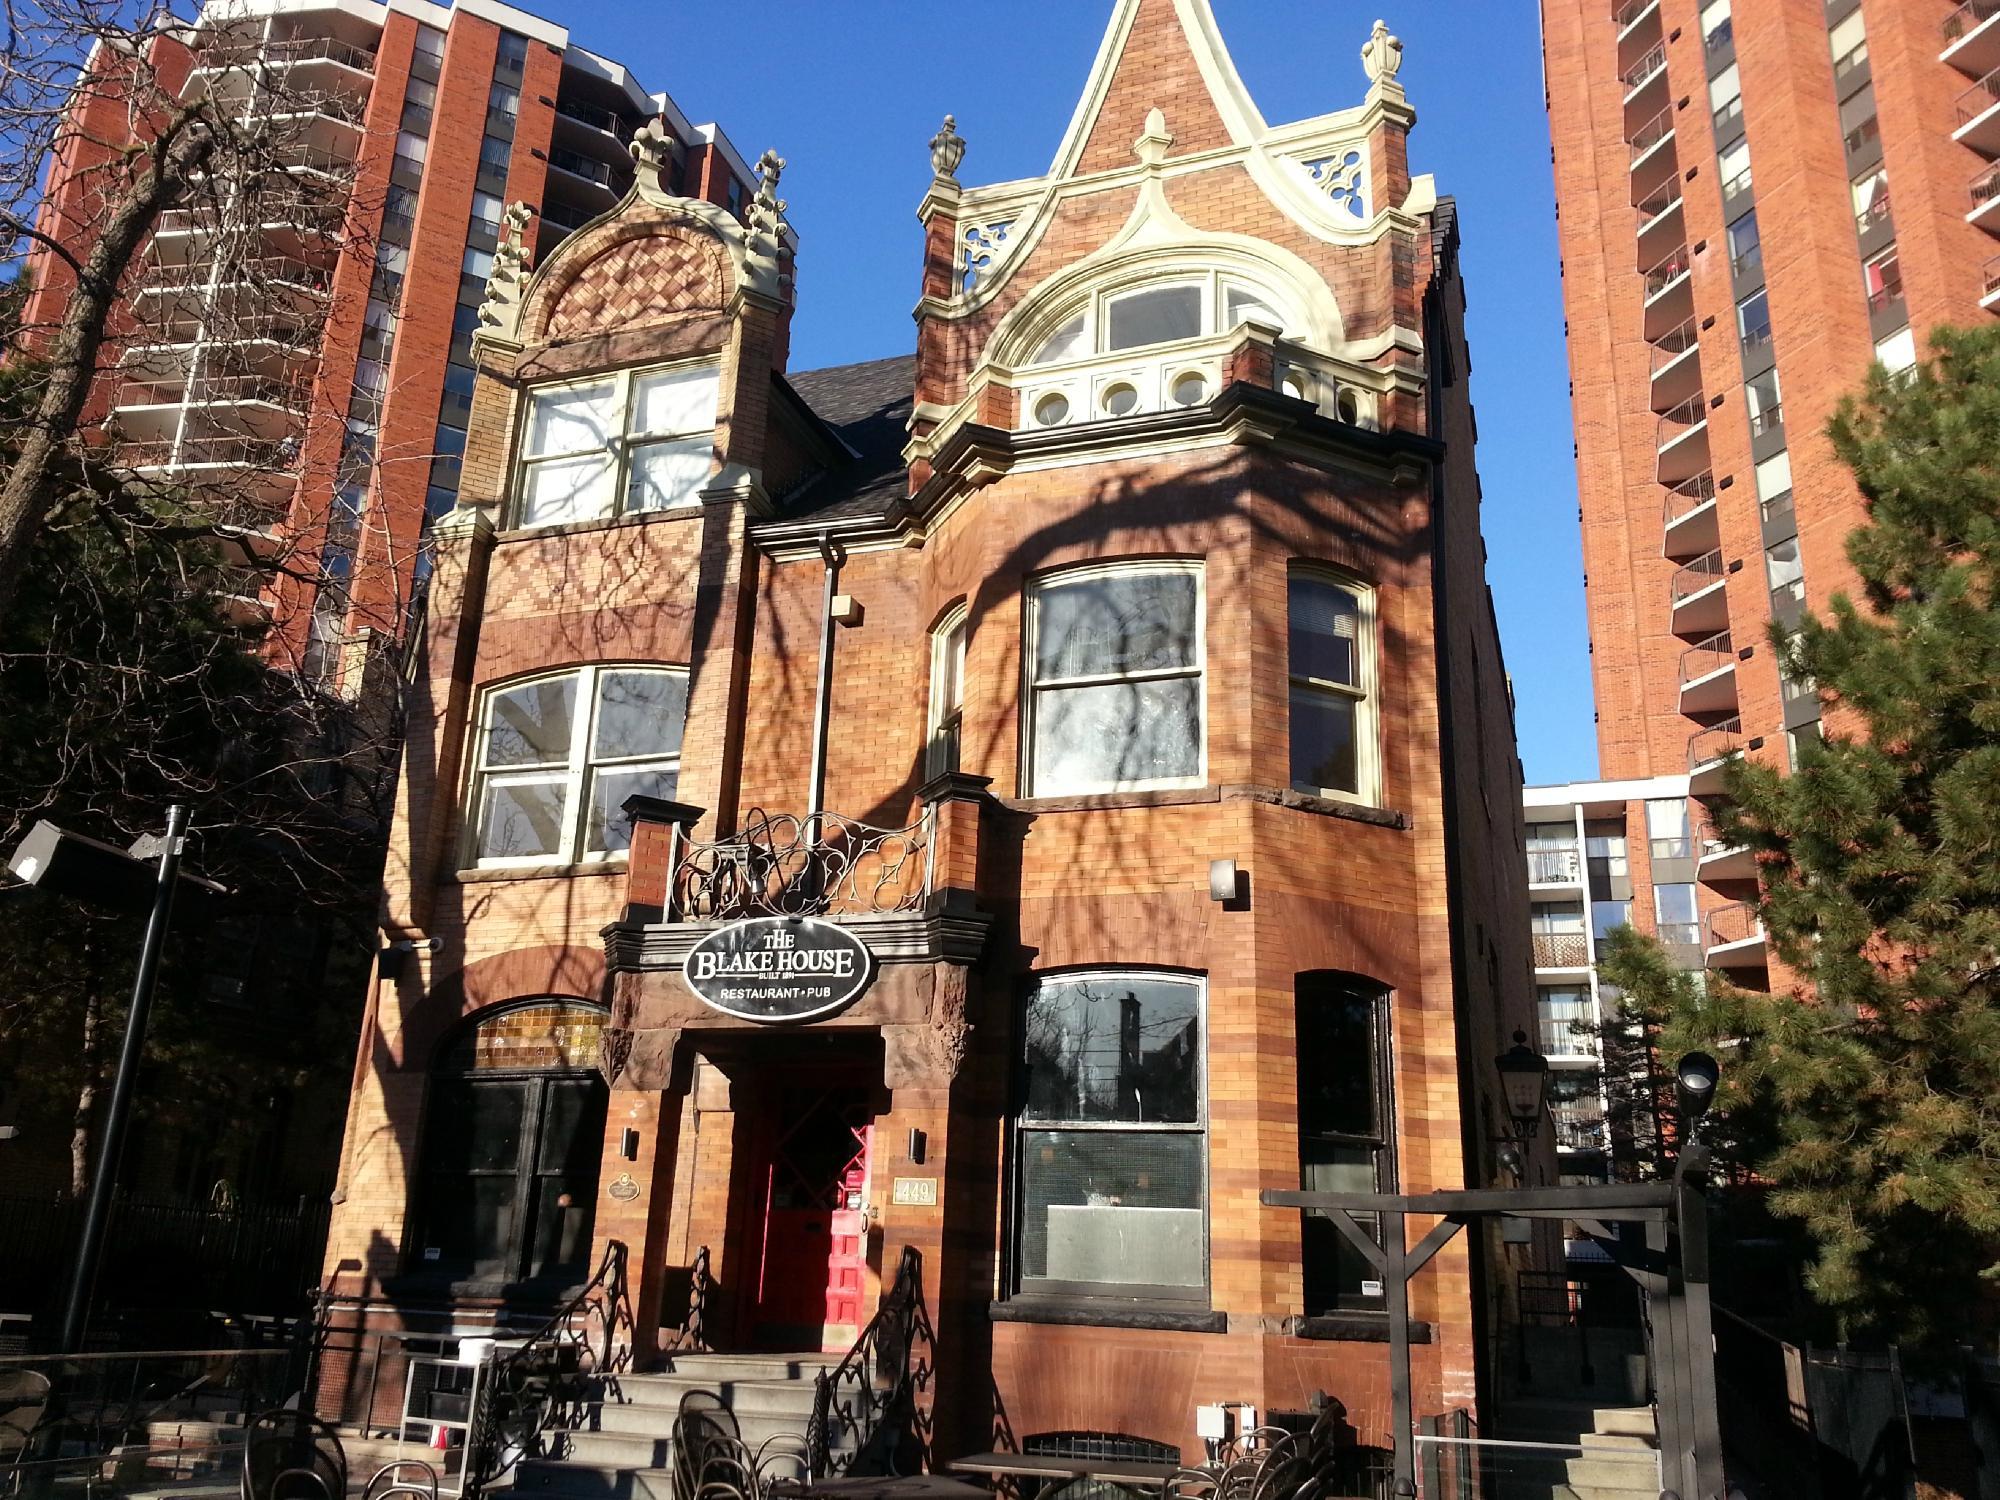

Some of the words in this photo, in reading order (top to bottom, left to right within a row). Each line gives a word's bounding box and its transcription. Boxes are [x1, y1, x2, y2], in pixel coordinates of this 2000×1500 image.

[763, 929, 795, 950] THE
[694, 951, 774, 979] BLAKE
[777, 949, 855, 978] HOUSE
[758, 971, 781, 980] BUILT
[720, 988, 800, 999] RESTAURANT
[807, 987, 831, 998] PUB
[903, 1182, 929, 1201] 449
